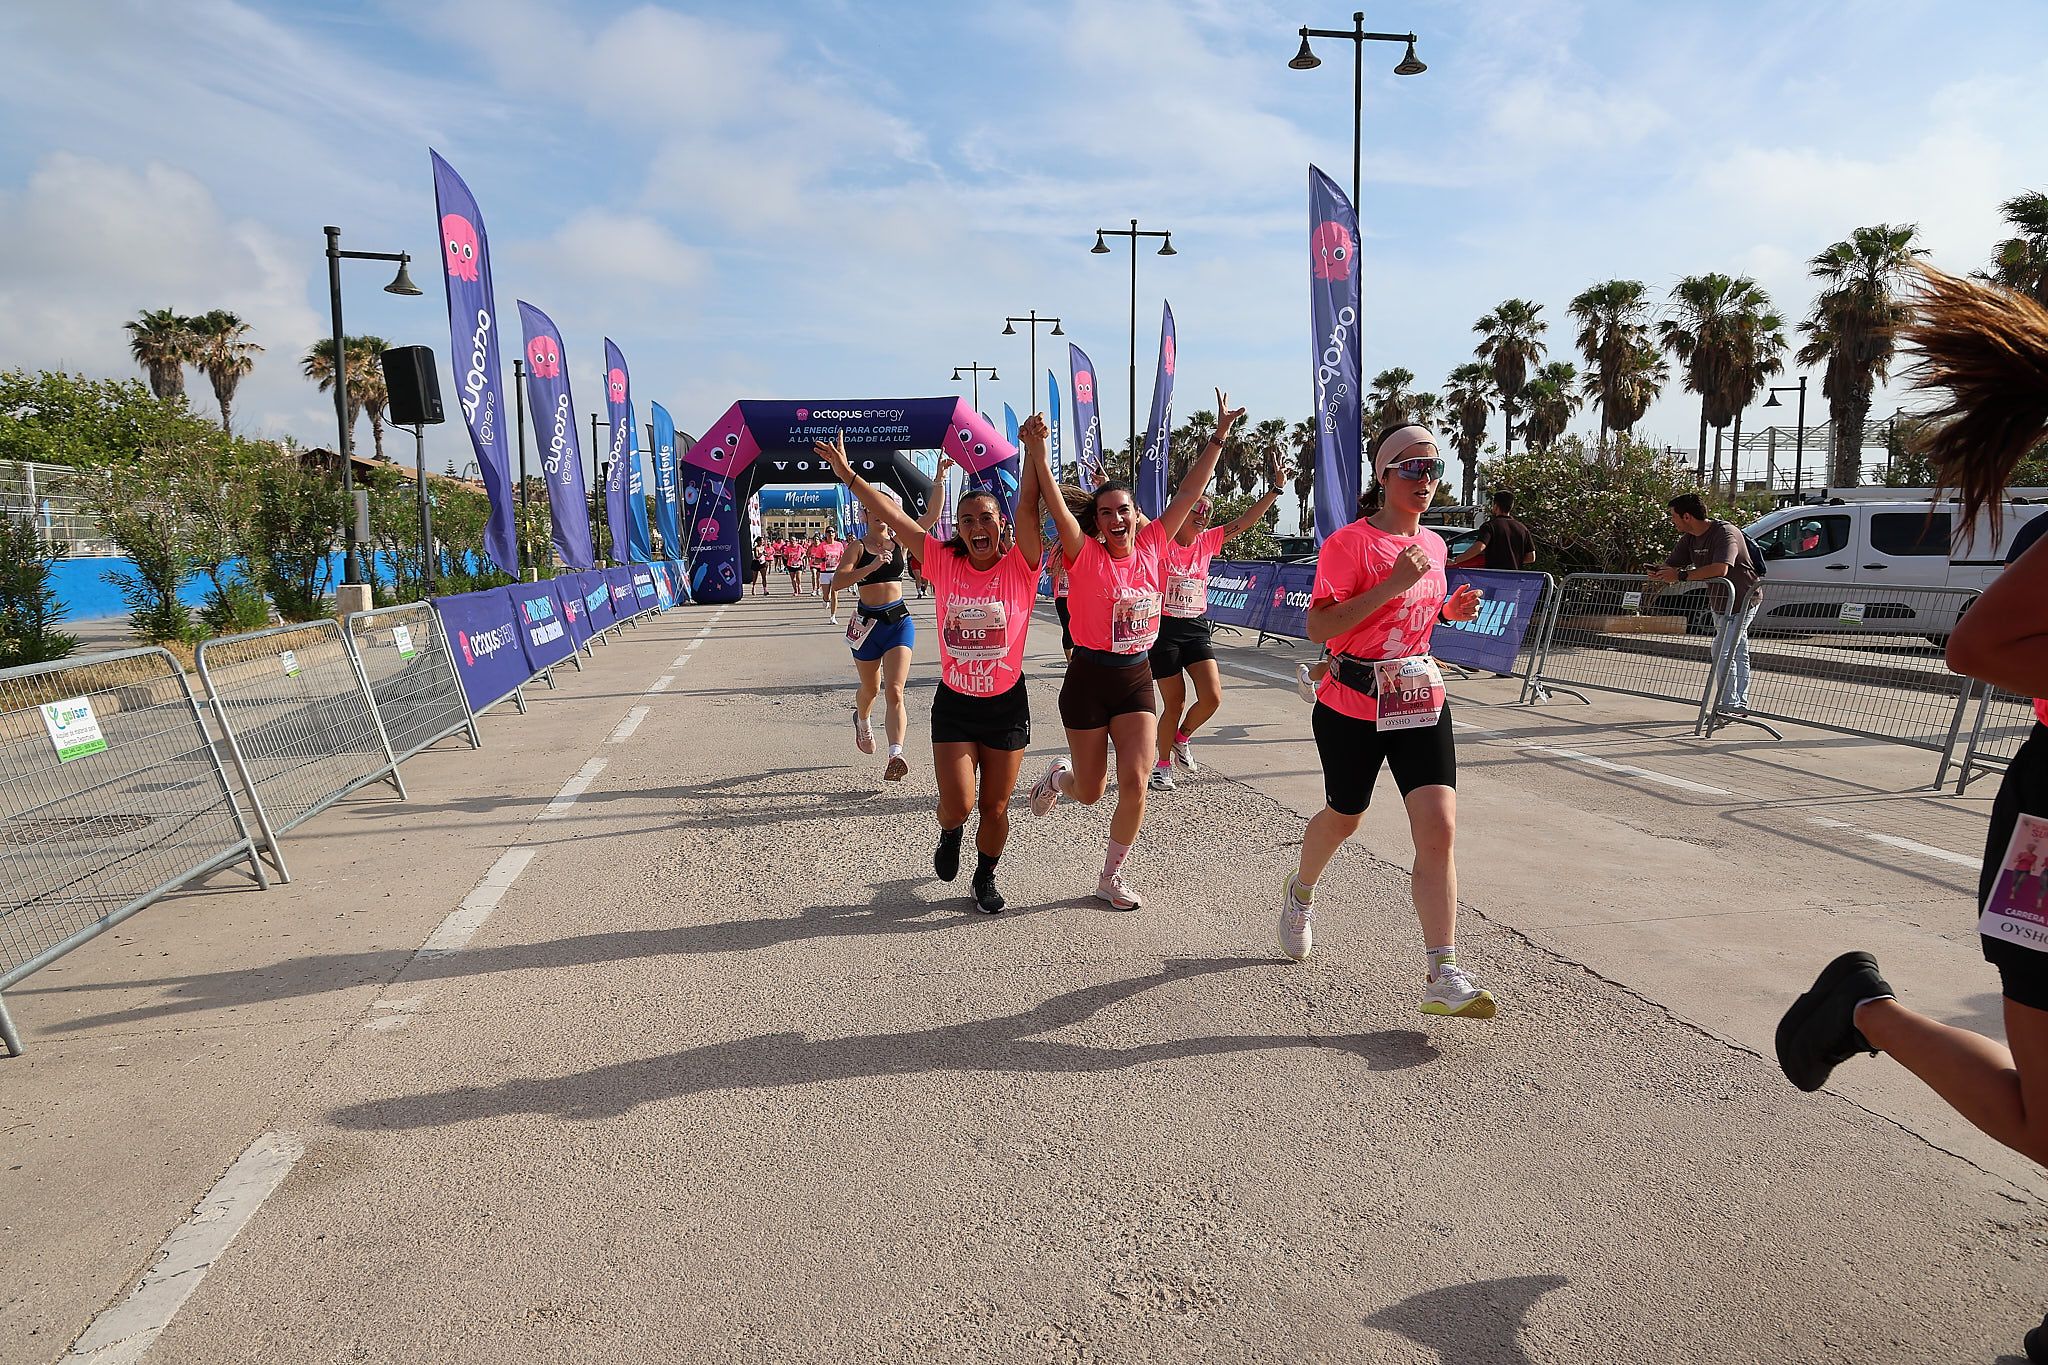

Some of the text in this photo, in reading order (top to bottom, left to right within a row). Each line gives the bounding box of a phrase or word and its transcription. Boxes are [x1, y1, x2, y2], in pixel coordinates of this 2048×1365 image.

[813, 409, 905, 421] octopus energy
[789, 426, 802, 434] LA
[845, 426, 870, 434] PARA
[872, 425, 909, 434] CORRER
[773, 460, 875, 471] VOLO
[1287, 590, 1312, 612] octop
[1131, 618, 1149, 630] 016
[961, 629, 986, 639] 016
[969, 660, 984, 675] LA
[949, 667, 994, 692] MUJER
[1402, 687, 1431, 702] 016
[1385, 718, 1410, 726] OYSHO
[2005, 907, 2045, 924] CARRERA
